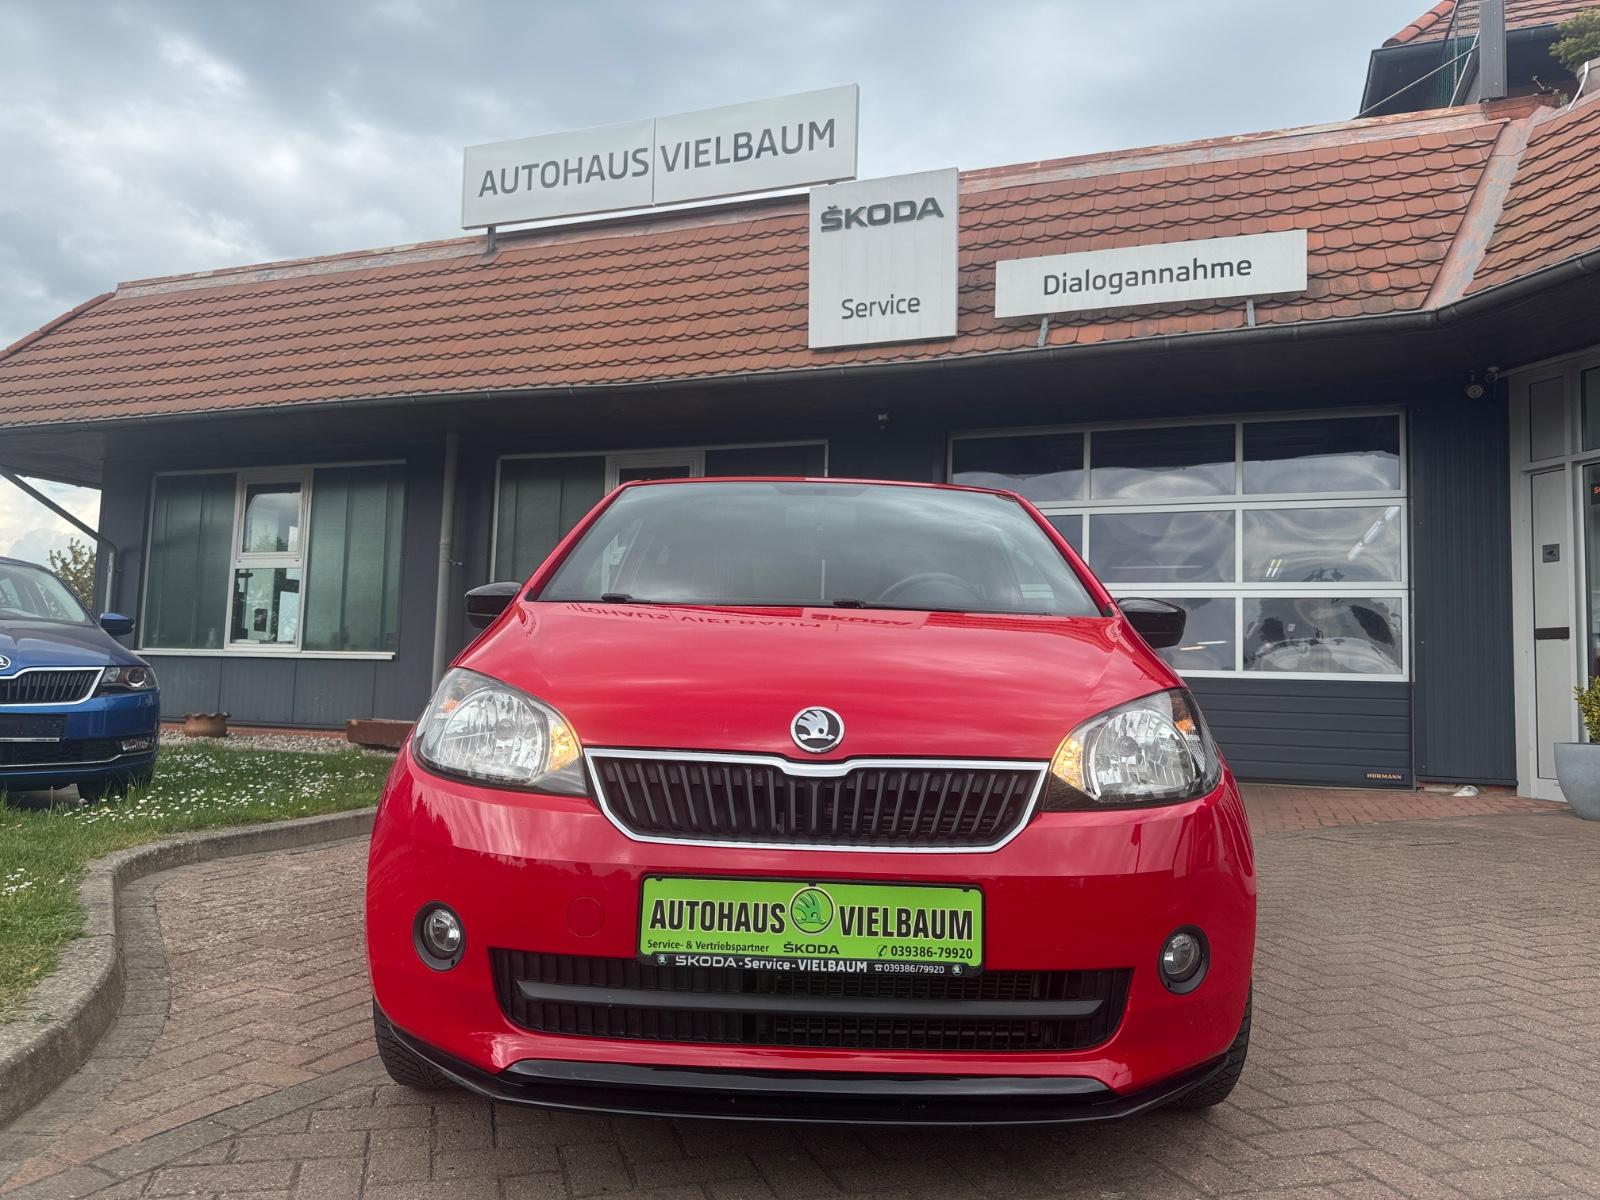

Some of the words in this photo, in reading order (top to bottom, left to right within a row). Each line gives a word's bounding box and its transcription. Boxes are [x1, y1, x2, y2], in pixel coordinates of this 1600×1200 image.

[478, 147, 650, 198] AUTOHAUS
[660, 118, 836, 173] VIELBAUM
[820, 197, 945, 233] ŠKODA
[1043, 258, 1253, 296] Dialogannahme
[841, 293, 921, 320] Service
[649, 899, 786, 934] AUTOHAUS
[838, 905, 973, 941] VIELBAUM
[647, 939, 684, 950] Service-
[686, 940, 693, 950] &
[695, 941, 770, 954] Vertriebspartner
[783, 941, 840, 955] ŠKODA
[890, 945, 973, 960] 039386-79920
[883, 963, 945, 975] 039386/79920
